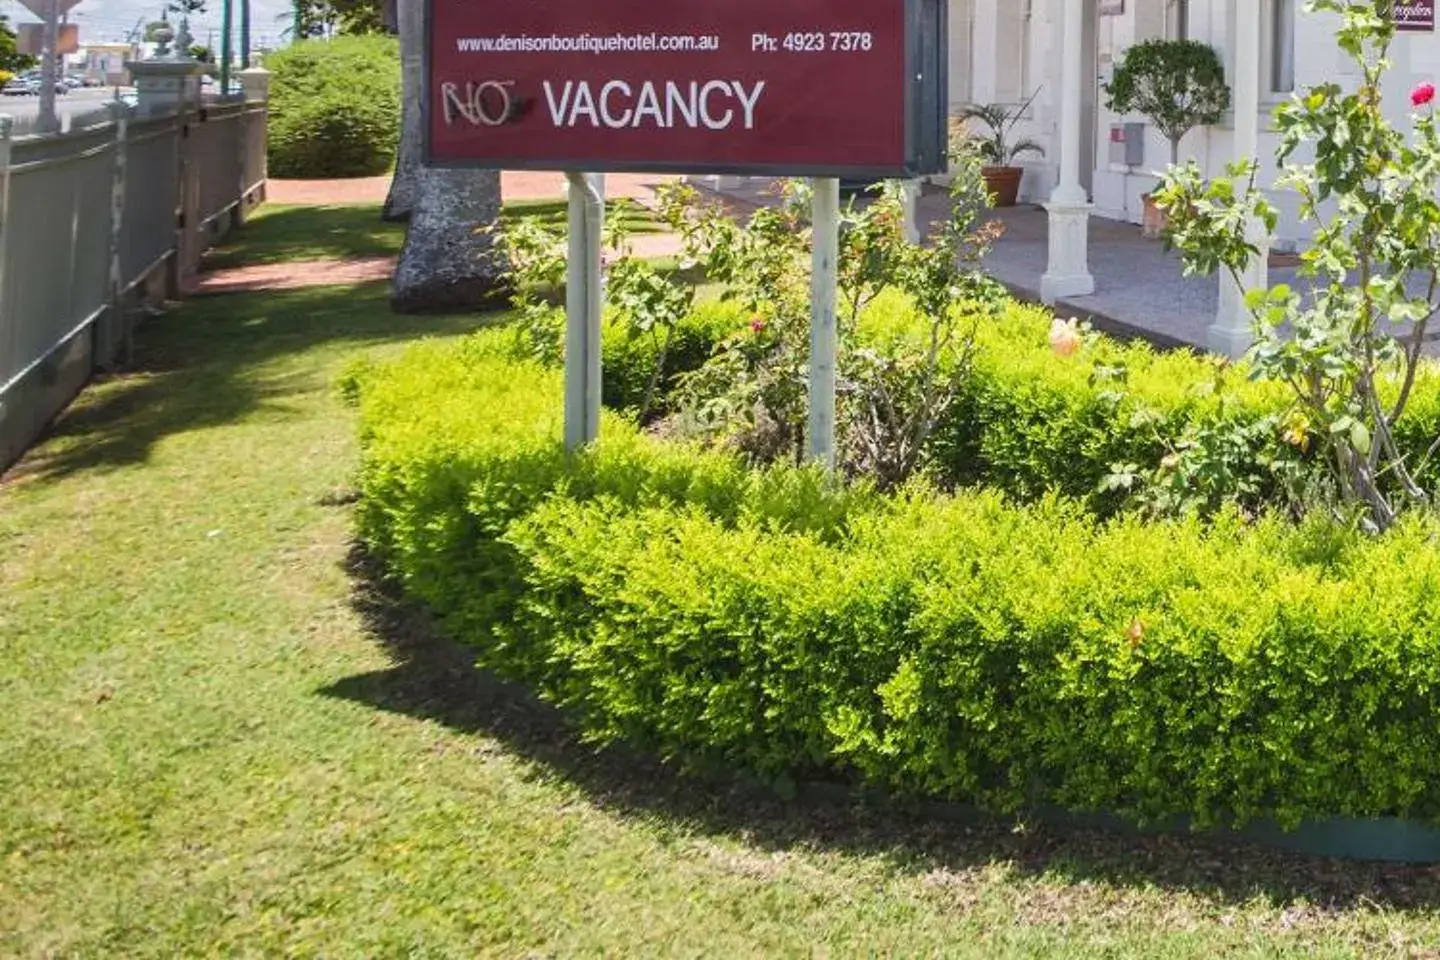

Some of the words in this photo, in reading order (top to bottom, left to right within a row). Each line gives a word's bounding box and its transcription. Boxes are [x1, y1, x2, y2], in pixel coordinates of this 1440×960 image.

[457, 34, 719, 54] www.denisonboutiquehotel.com.au
[752, 34, 777, 51] Ph:
[783, 33, 824, 51] 4923
[830, 32, 872, 50] 7378
[543, 80, 765, 128] VACANCY
